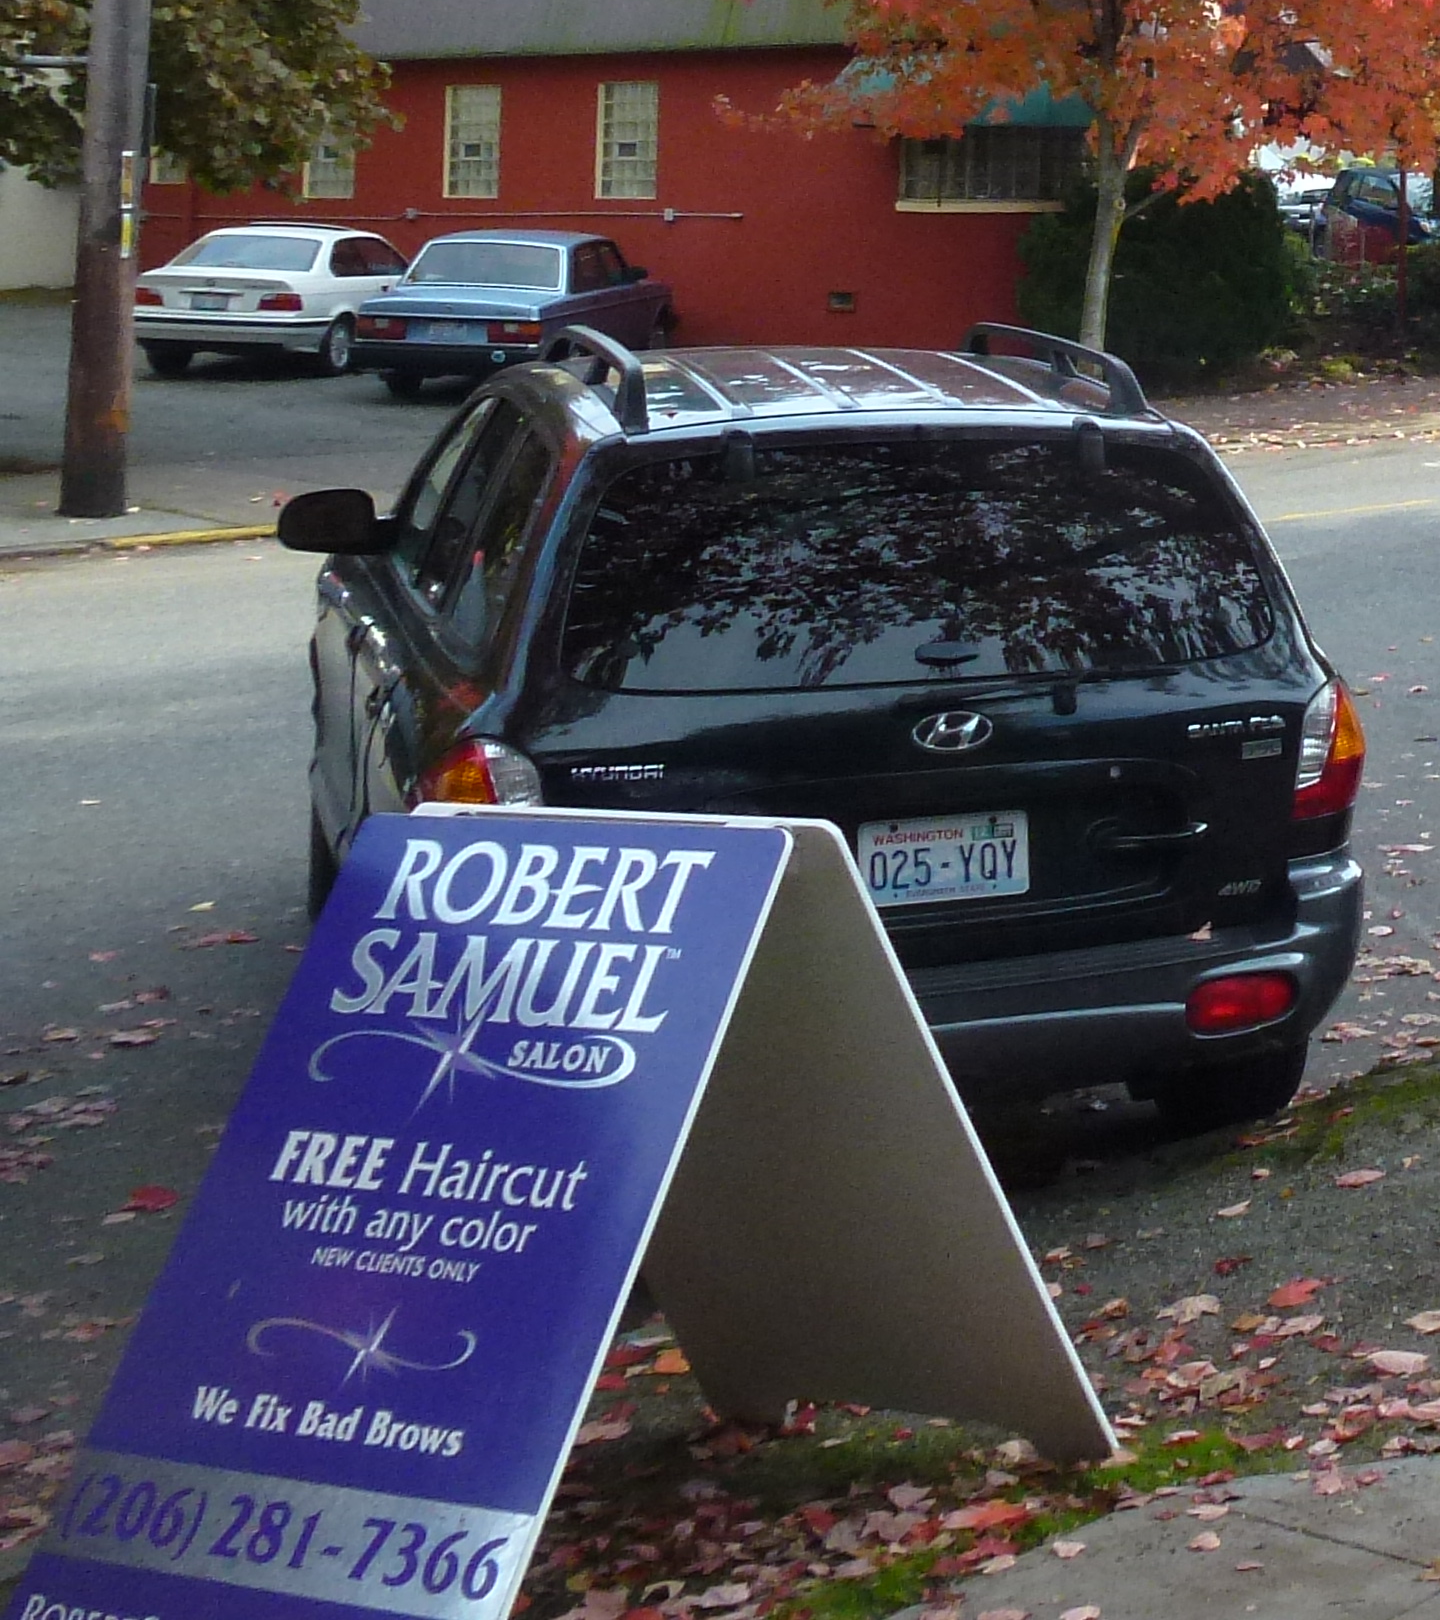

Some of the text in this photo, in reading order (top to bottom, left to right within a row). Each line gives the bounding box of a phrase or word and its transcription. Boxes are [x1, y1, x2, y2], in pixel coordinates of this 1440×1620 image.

[570, 764, 665, 781] HYUNDAI
[869, 838, 1018, 891] 025-YQY
[872, 828, 965, 847] WASHINGTON
[373, 838, 717, 934] ROBERT
[330, 928, 669, 1033] SAMUEL
[507, 1040, 612, 1073] SALON
[269, 1130, 588, 1212] FREE Haircut
[281, 1194, 538, 1253] with any color
[311, 1246, 482, 1284] NEW CLIENTS ONLY
[191, 1385, 464, 1457] We Fix Bad Brows
[61, 1476, 509, 1602] (206) 281-7366
